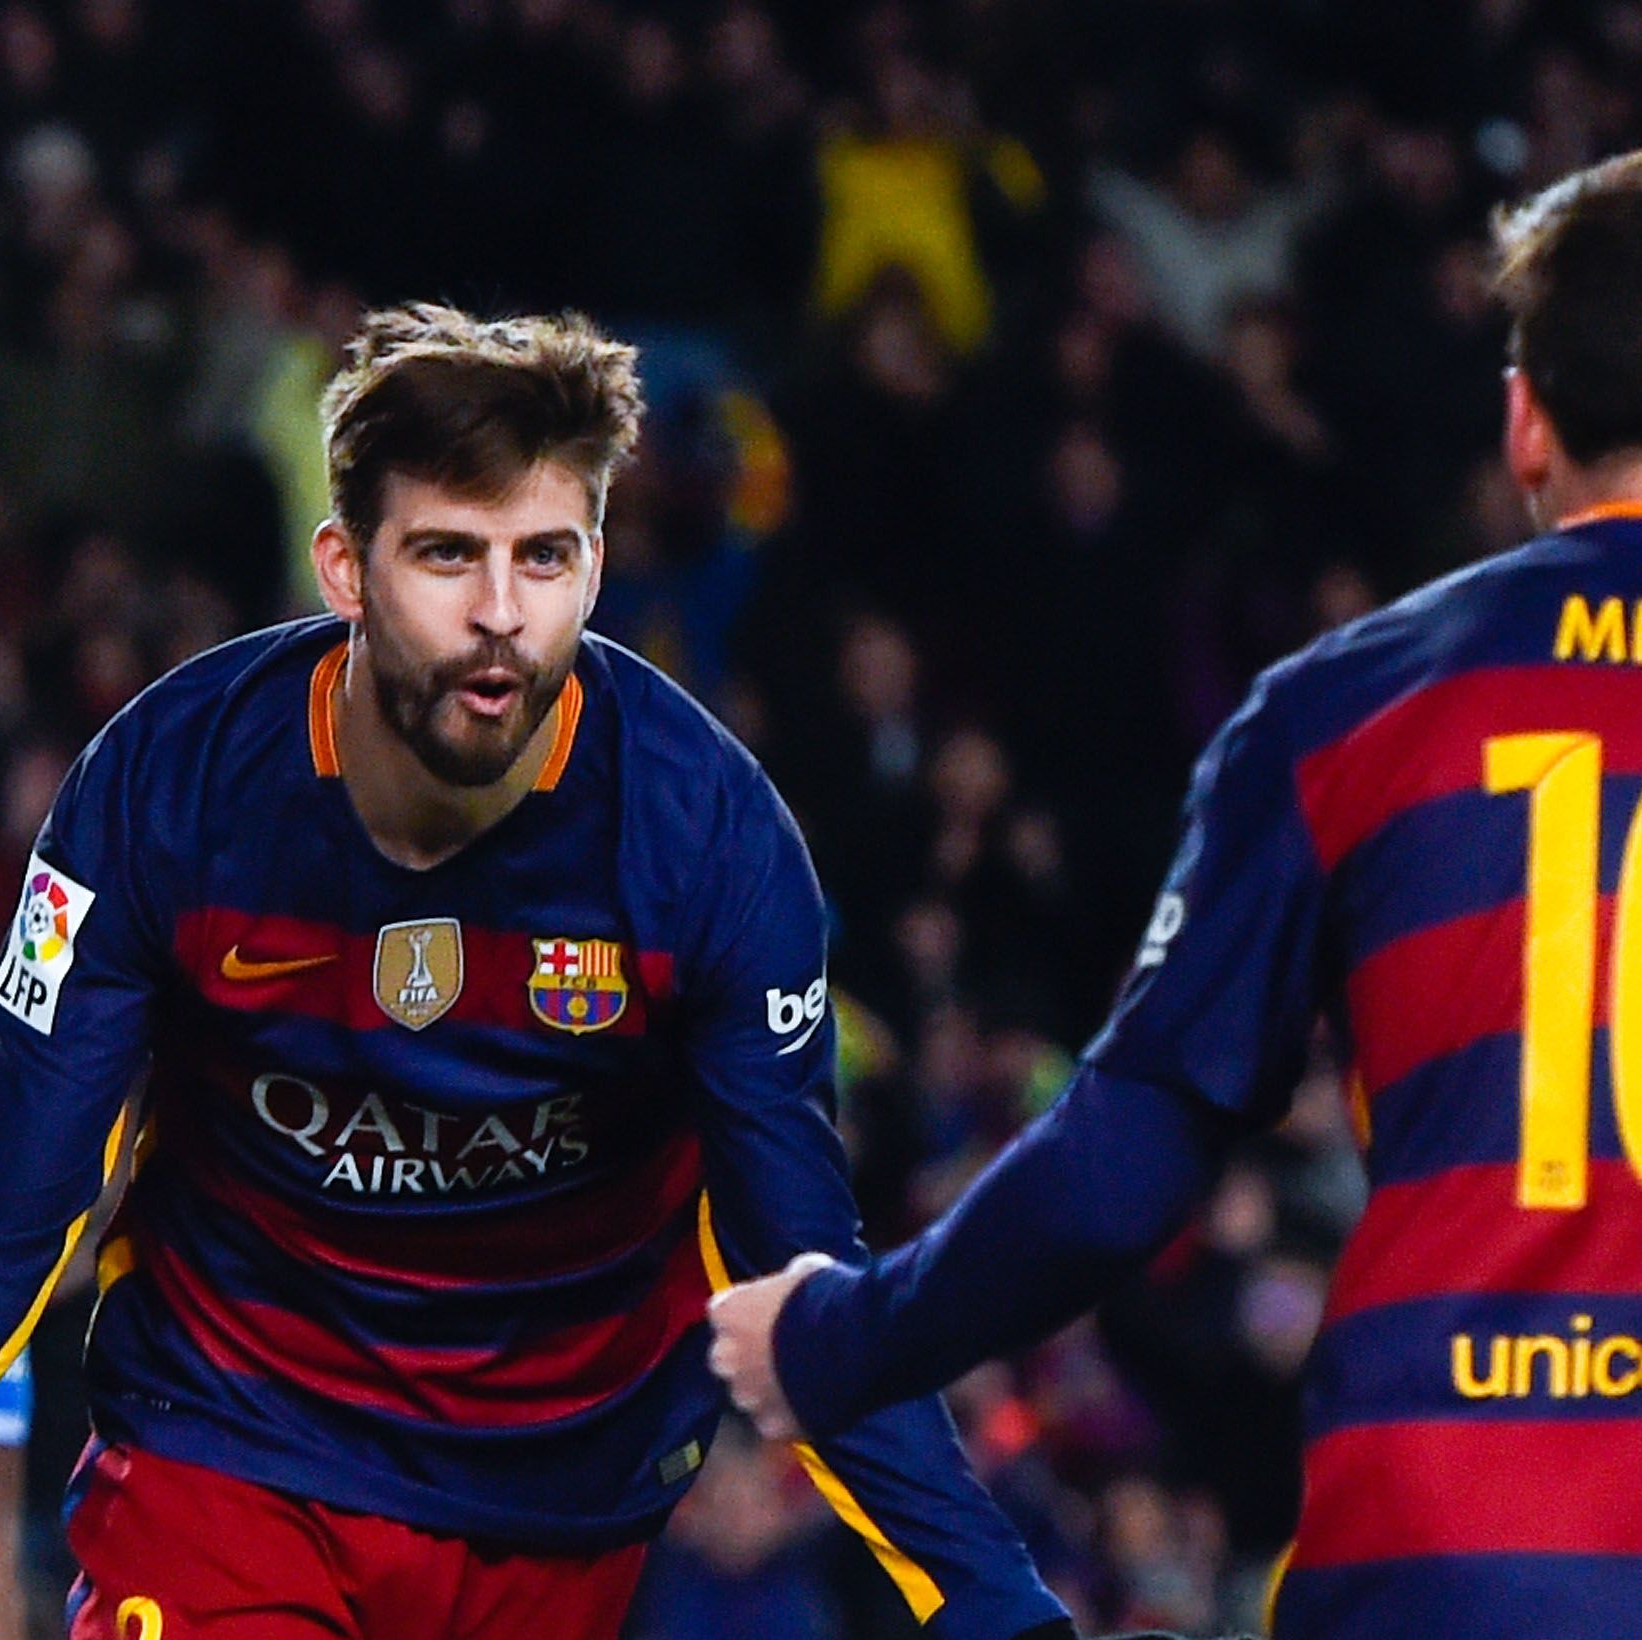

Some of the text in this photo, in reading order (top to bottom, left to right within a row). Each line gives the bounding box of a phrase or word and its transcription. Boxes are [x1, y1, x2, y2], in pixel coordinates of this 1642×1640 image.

[398, 987, 439, 1004] FIFA
[251, 1072, 583, 1161] QATAR
[321, 1127, 589, 1193] AIRWAYS
